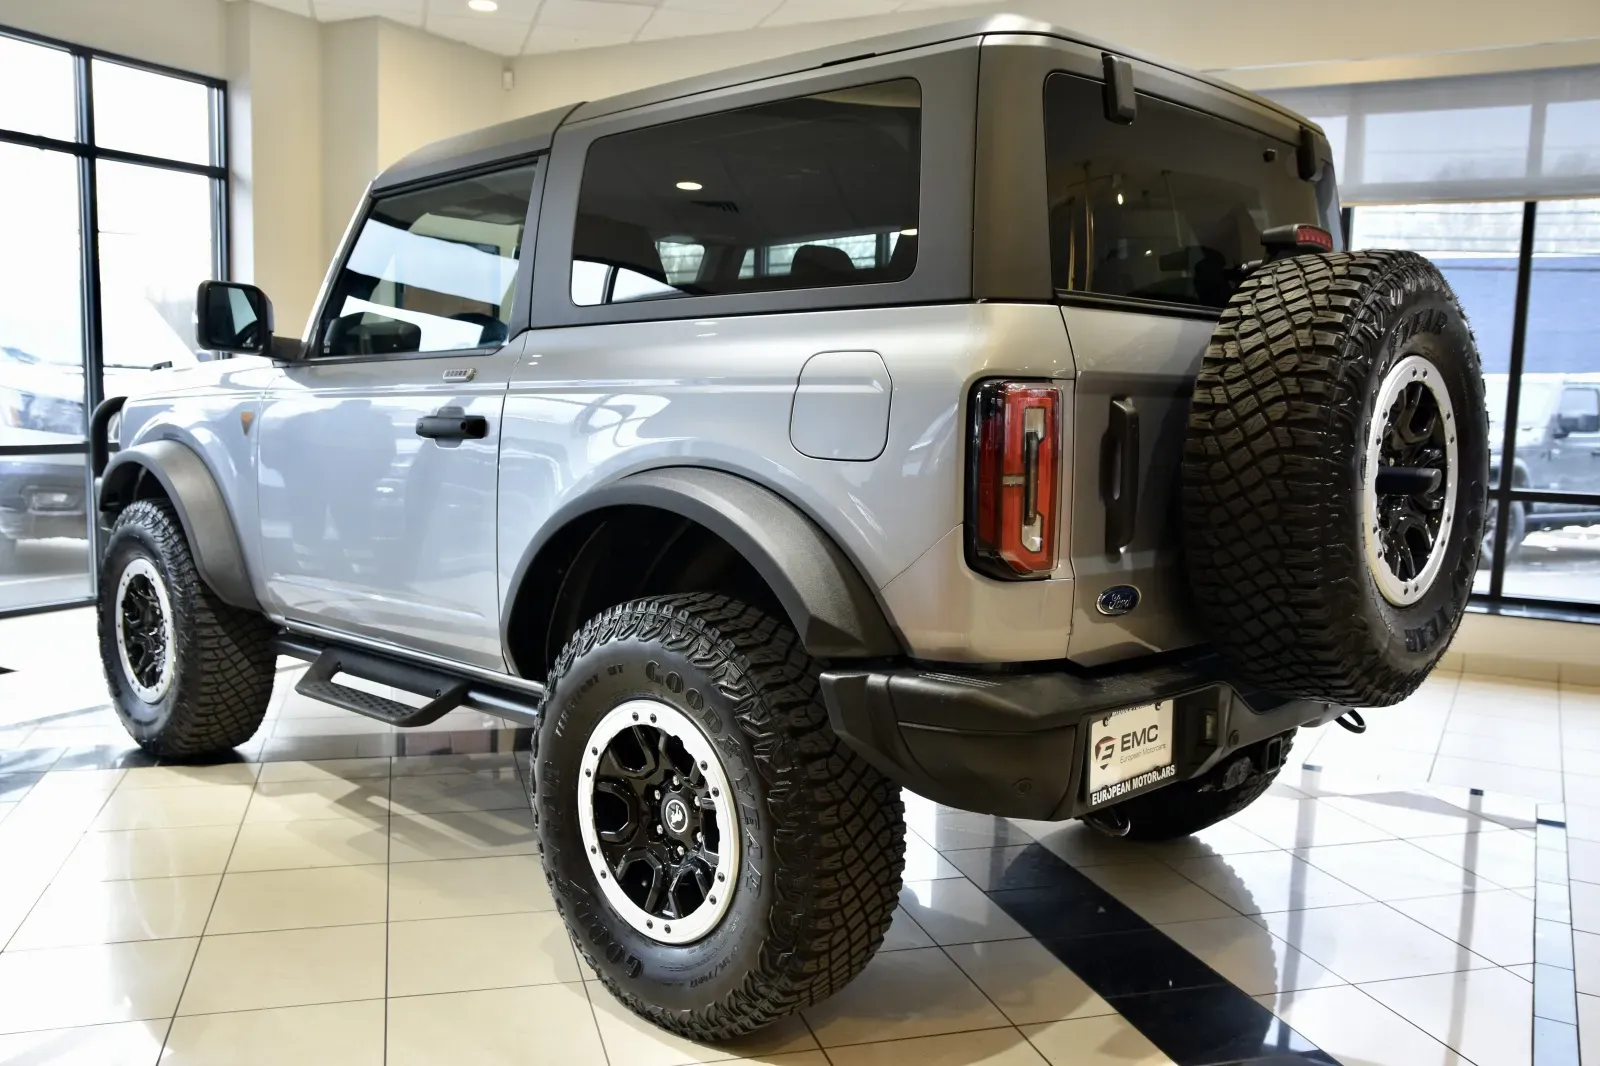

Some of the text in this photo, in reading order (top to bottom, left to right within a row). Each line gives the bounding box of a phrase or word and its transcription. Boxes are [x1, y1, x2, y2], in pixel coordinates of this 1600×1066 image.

[1120, 724, 1159, 752] EMC
[1119, 743, 1167, 764] European Motorcars
[1091, 780, 1131, 806] EUROPEAN
